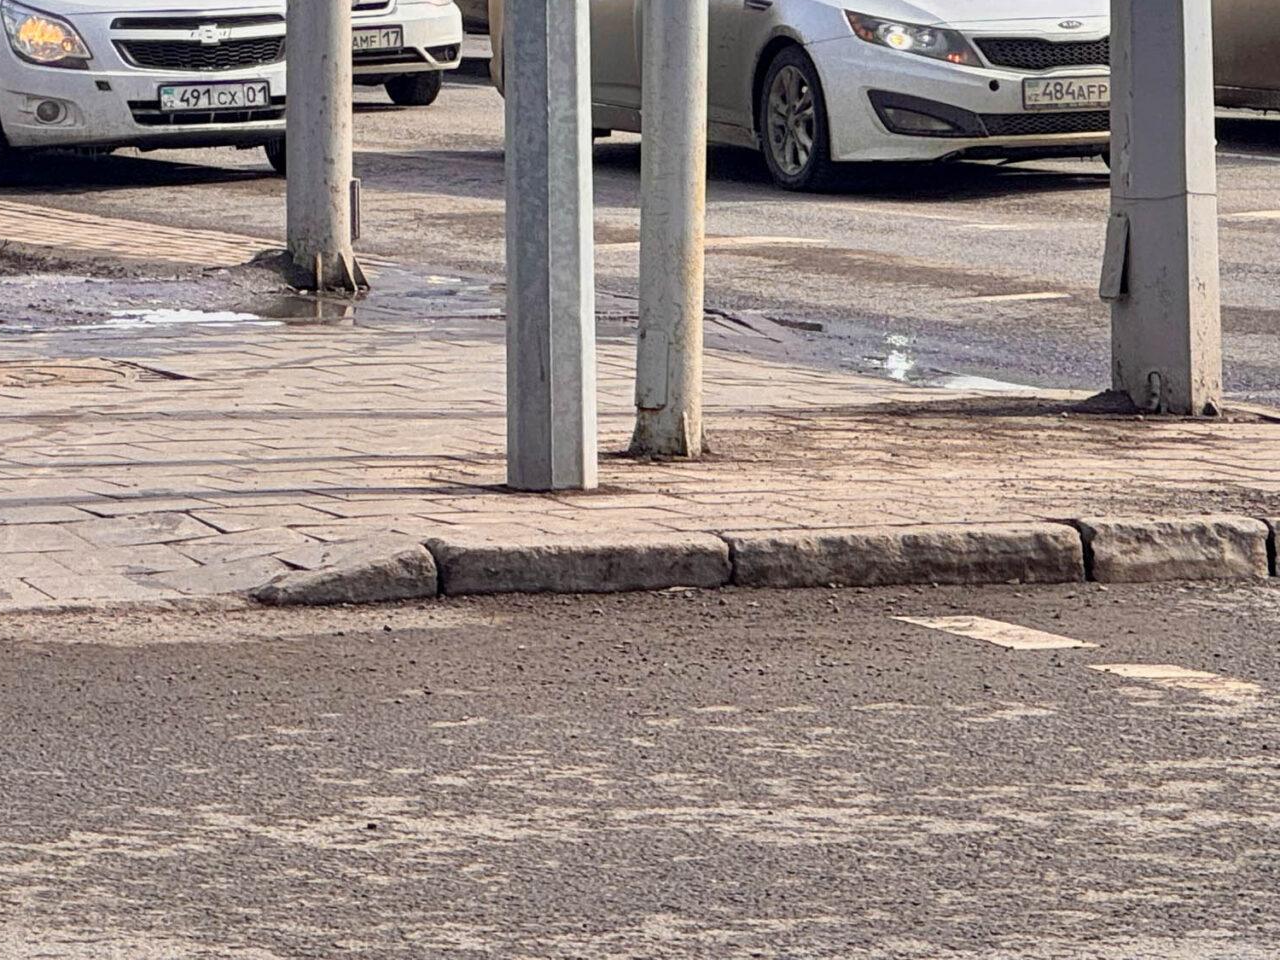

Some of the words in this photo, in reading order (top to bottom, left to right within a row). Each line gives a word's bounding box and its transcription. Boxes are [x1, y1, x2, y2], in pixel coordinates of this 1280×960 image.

[382, 29, 401, 47] 17
[180, 89, 213, 108] 491
[218, 90, 238, 105] CX
[246, 87, 268, 104] 01
